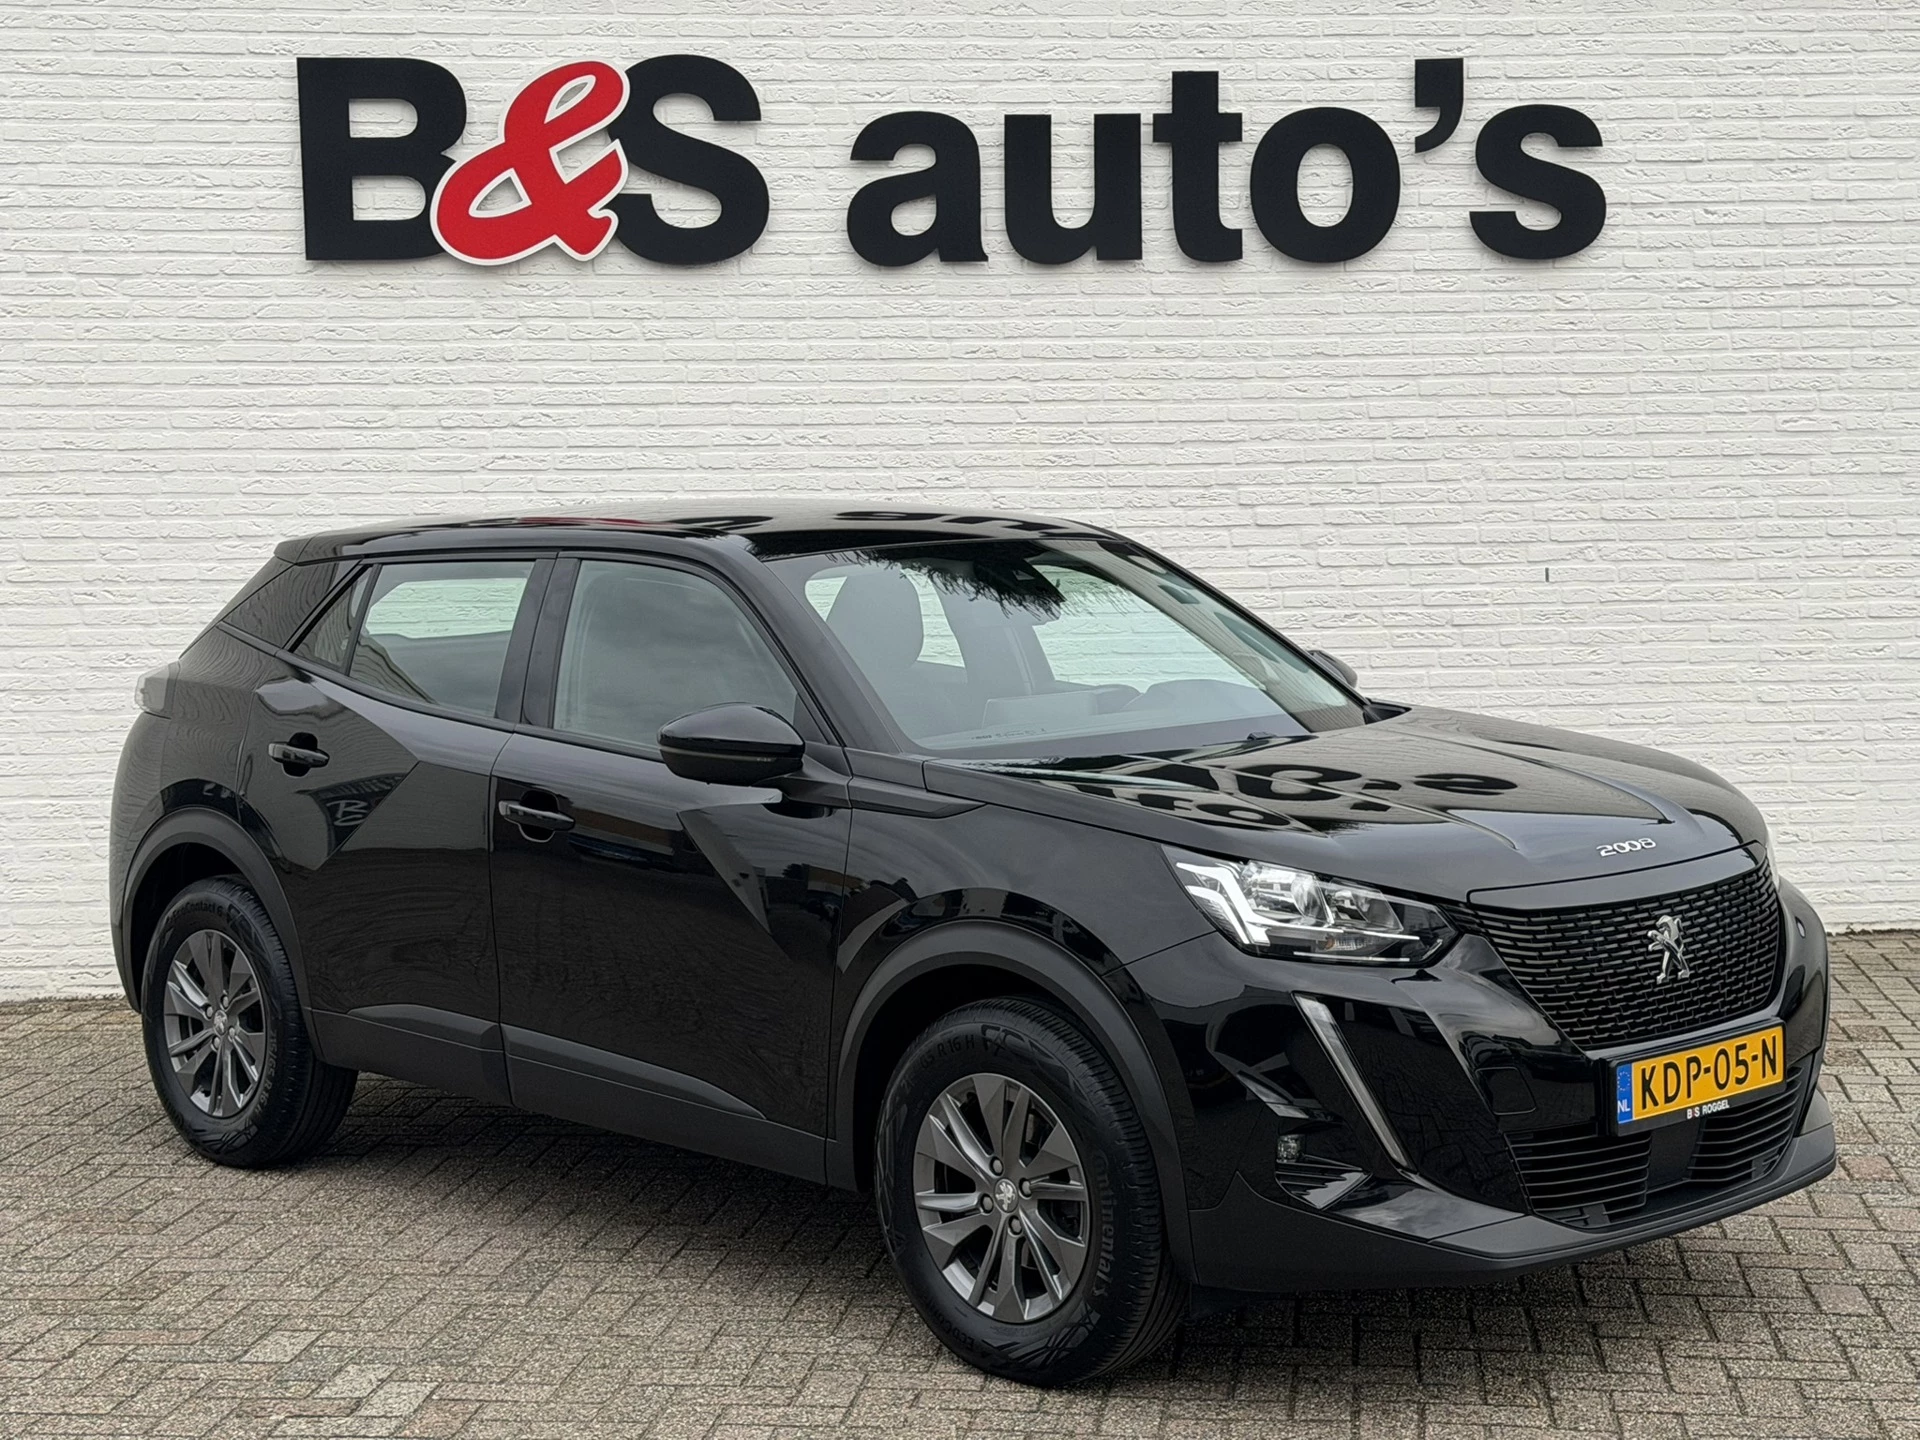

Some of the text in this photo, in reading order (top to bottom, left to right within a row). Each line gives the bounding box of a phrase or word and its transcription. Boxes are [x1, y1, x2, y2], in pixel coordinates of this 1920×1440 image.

[296, 53, 1607, 266] B&S auto's
[1596, 838, 1656, 857] 2008
[1641, 1035, 1777, 1110] KDP-05-N
[1617, 1100, 1631, 1114] NL
[1702, 1099, 1730, 1115] ROGGEL
